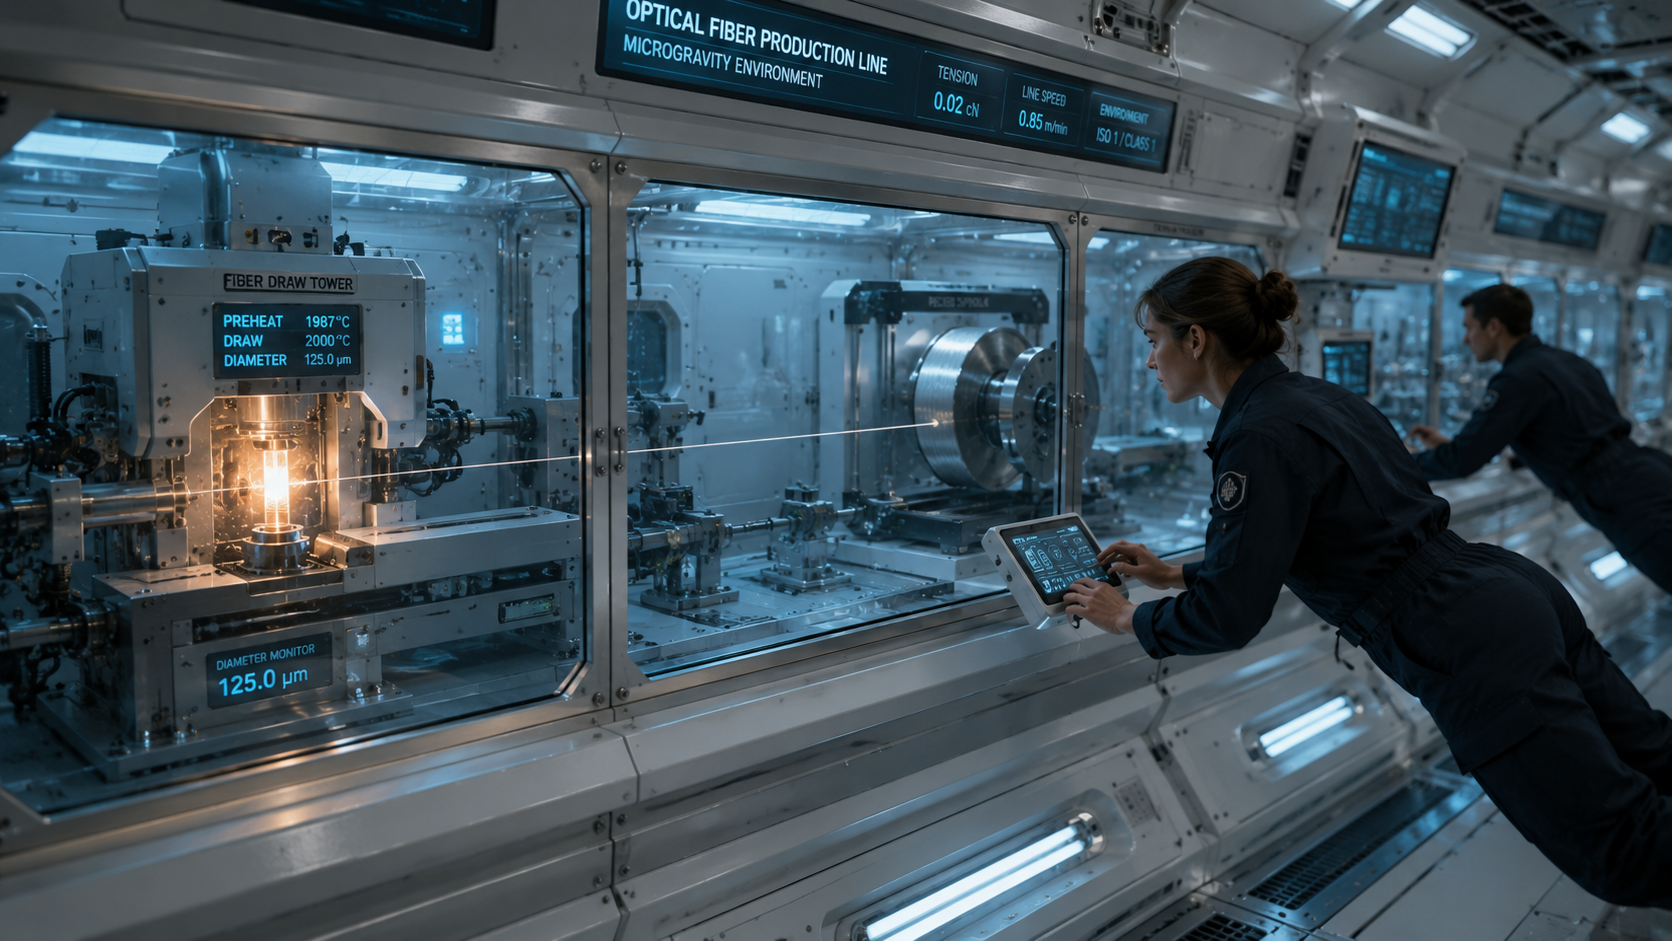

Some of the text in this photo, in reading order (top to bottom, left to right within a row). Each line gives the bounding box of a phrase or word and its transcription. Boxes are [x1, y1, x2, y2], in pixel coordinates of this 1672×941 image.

[626, 0, 888, 75] OPTICAL FIBER PRODUCTION LINE
[623, 33, 823, 89] MICROGRAVITY ENVIRONMENT
[938, 65, 978, 86] TENSION
[934, 91, 979, 118] 0.02 cN
[1022, 85, 1067, 107] LINE SPEED
[1018, 109, 1068, 135] 0.85 m/min
[1096, 127, 1112, 144] ISO
[224, 273, 353, 290] FIBER DRAW TOWER
[223, 314, 284, 328] PREHEAT
[224, 334, 263, 347] DRAW
[224, 354, 287, 367] DIAMETER
[304, 353, 334, 366] 125.0
[216, 644, 315, 671] DIAMETER MONITOR
[218, 669, 276, 697] 125.0
